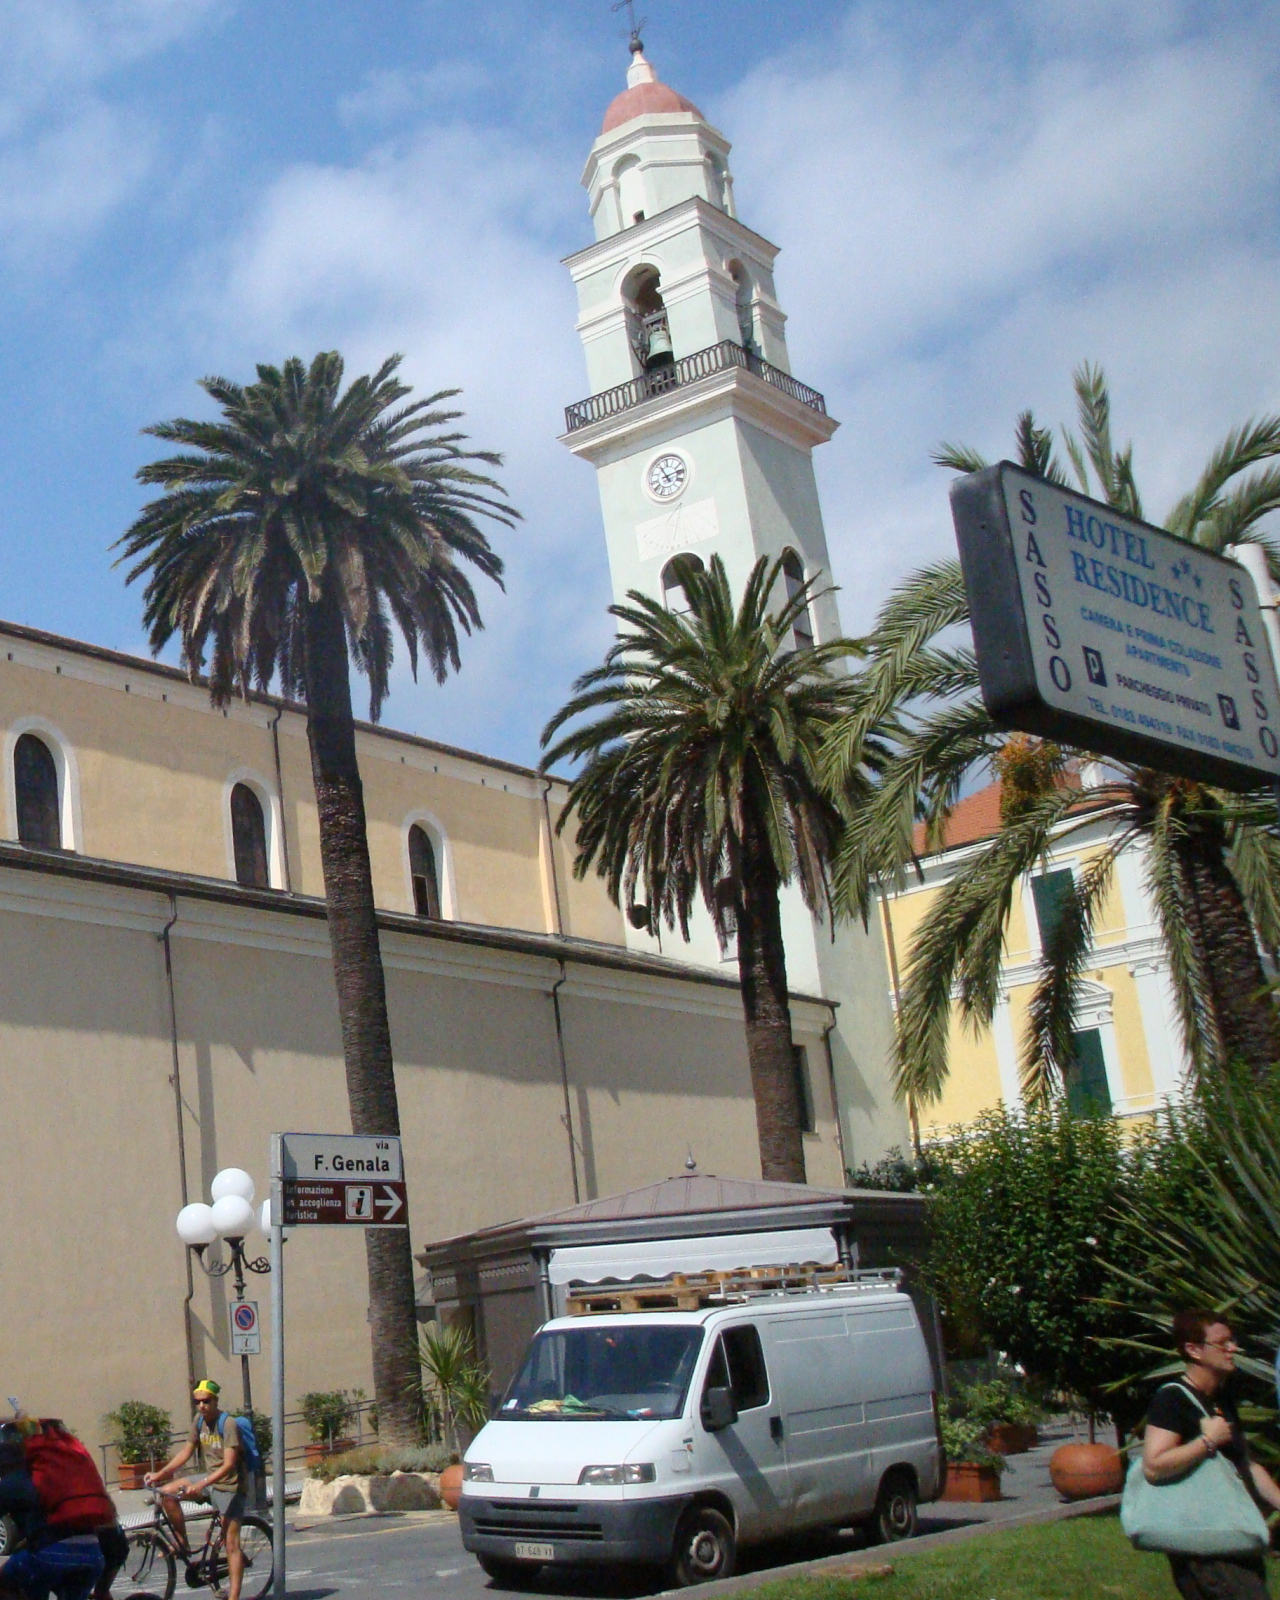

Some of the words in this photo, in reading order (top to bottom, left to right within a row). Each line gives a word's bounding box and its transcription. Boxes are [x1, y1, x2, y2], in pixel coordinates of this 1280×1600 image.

[1063, 504, 1155, 571] HOTEL
[1019, 489, 1072, 693] SASSO
[1070, 550, 1215, 634] RESIDENCE
[1228, 578, 1279, 758] SASSO
[332, 1154, 390, 1172] Genala
[375, 1140, 389, 1150] via
[299, 1197, 342, 1209] accoglienza
